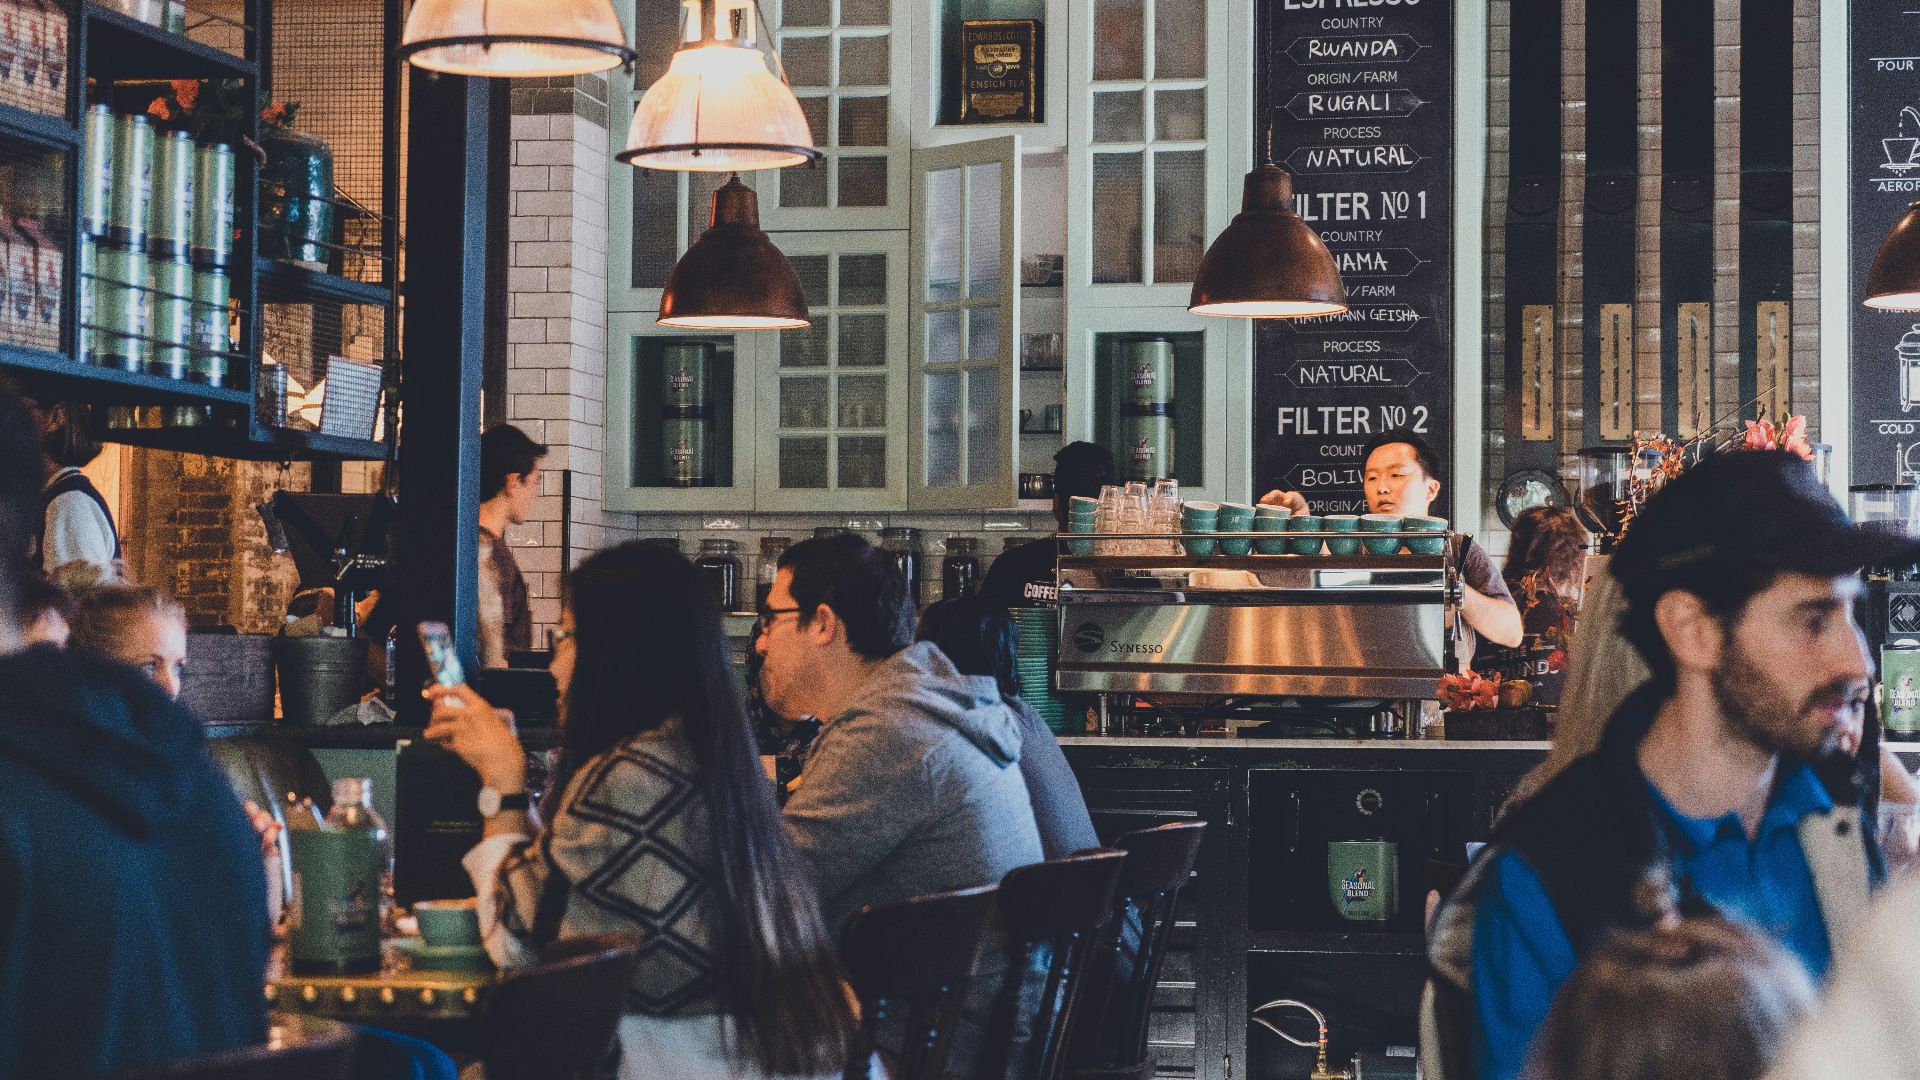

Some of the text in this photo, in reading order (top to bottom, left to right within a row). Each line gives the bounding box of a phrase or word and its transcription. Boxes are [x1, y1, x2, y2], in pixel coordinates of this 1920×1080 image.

[1321, 17, 1384, 29] COUNTRY
[1309, 39, 1398, 59] RWANDA
[1877, 60, 1914, 71] POUR
[971, 80, 1005, 89] ENSIGN
[1309, 93, 1390, 114] RUGALI
[1324, 127, 1381, 139] PROCESS
[1307, 147, 1413, 168] NATURAL
[1292, 192, 1370, 221] ILTER
[1418, 191, 1426, 219] 1
[1321, 230, 1383, 242] COUNTRY
[1369, 308, 1419, 322] GEISHA
[1323, 341, 1381, 353] PROCESS
[1300, 365, 1392, 384] NATURAL
[1278, 406, 1371, 435] FILTER
[1412, 405, 1428, 434] 2
[1879, 423, 1914, 434] COLD
[1320, 445, 1365, 457] COUNT
[1341, 879, 1375, 889] SEASONAL
